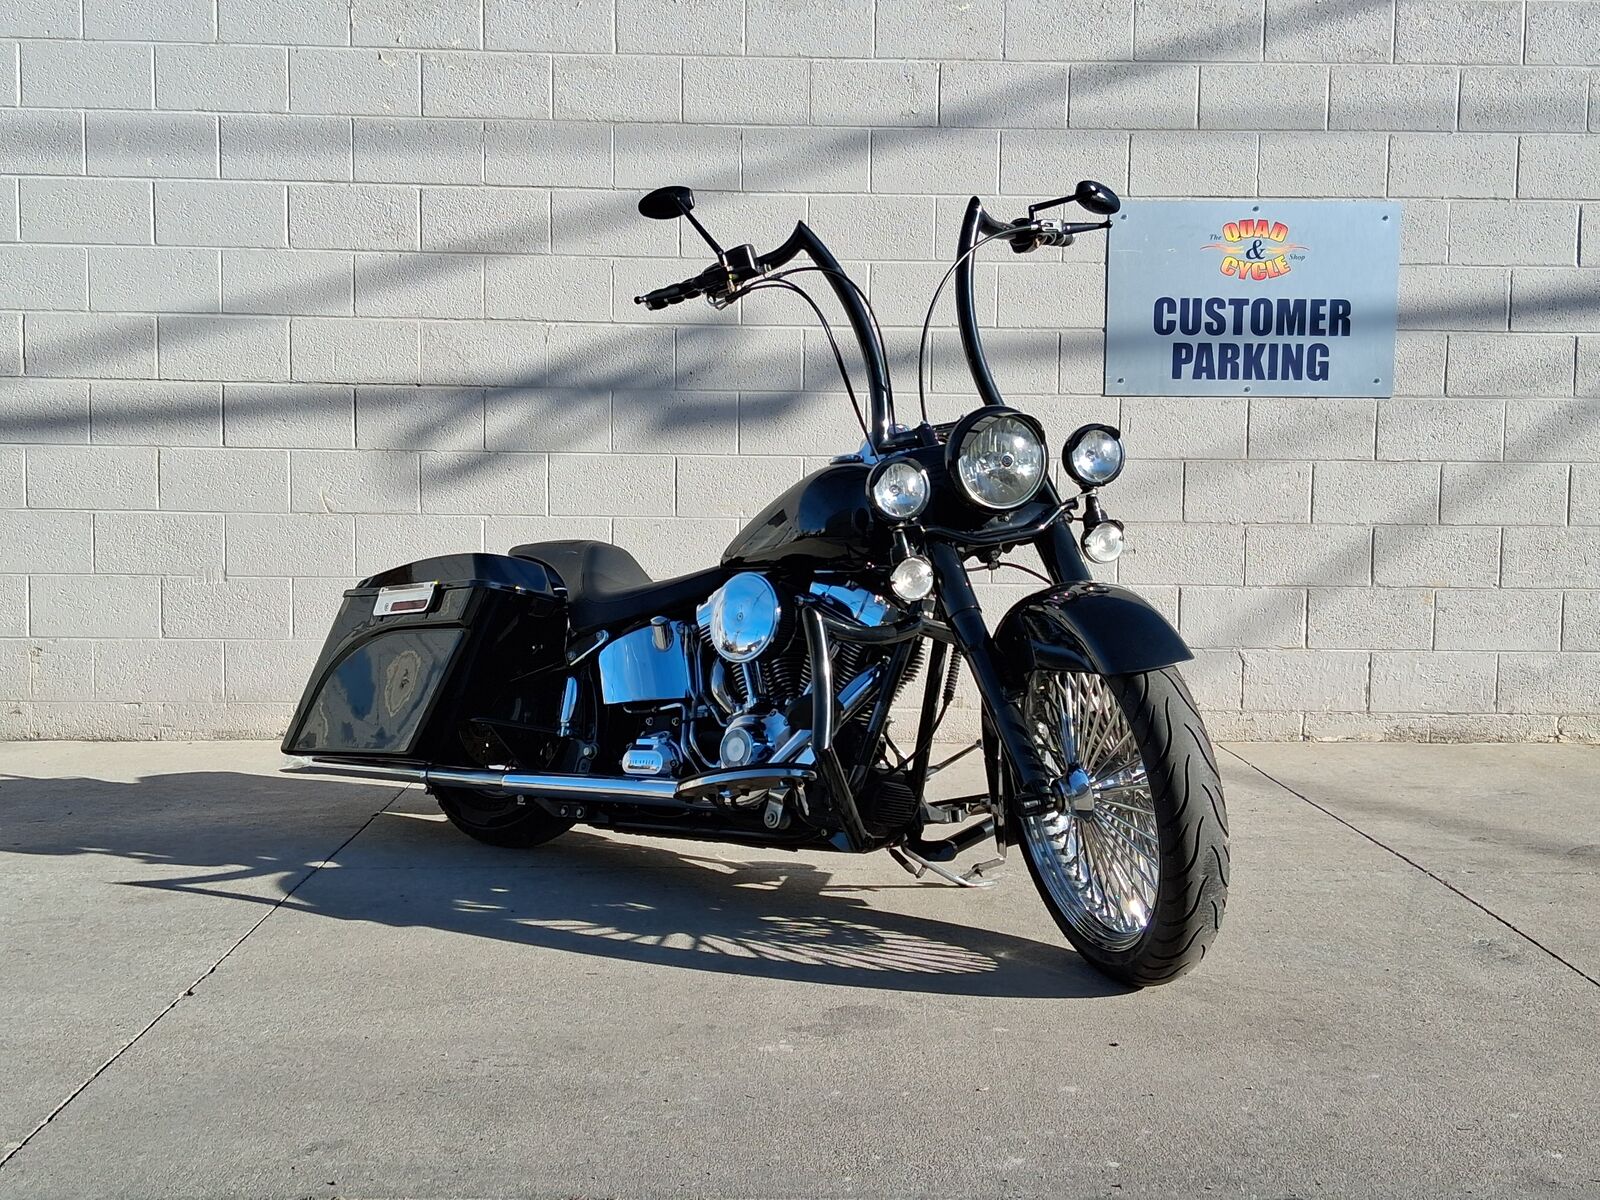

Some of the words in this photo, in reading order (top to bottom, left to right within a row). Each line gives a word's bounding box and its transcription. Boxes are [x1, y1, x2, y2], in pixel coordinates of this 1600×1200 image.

[1222, 219, 1288, 243] QUAD
[1245, 239, 1265, 260] &
[1289, 253, 1306, 262] Shop
[1220, 255, 1291, 281] CYCLE
[1153, 297, 1351, 336] CUSTOMER
[1171, 342, 1330, 381] PARKING
